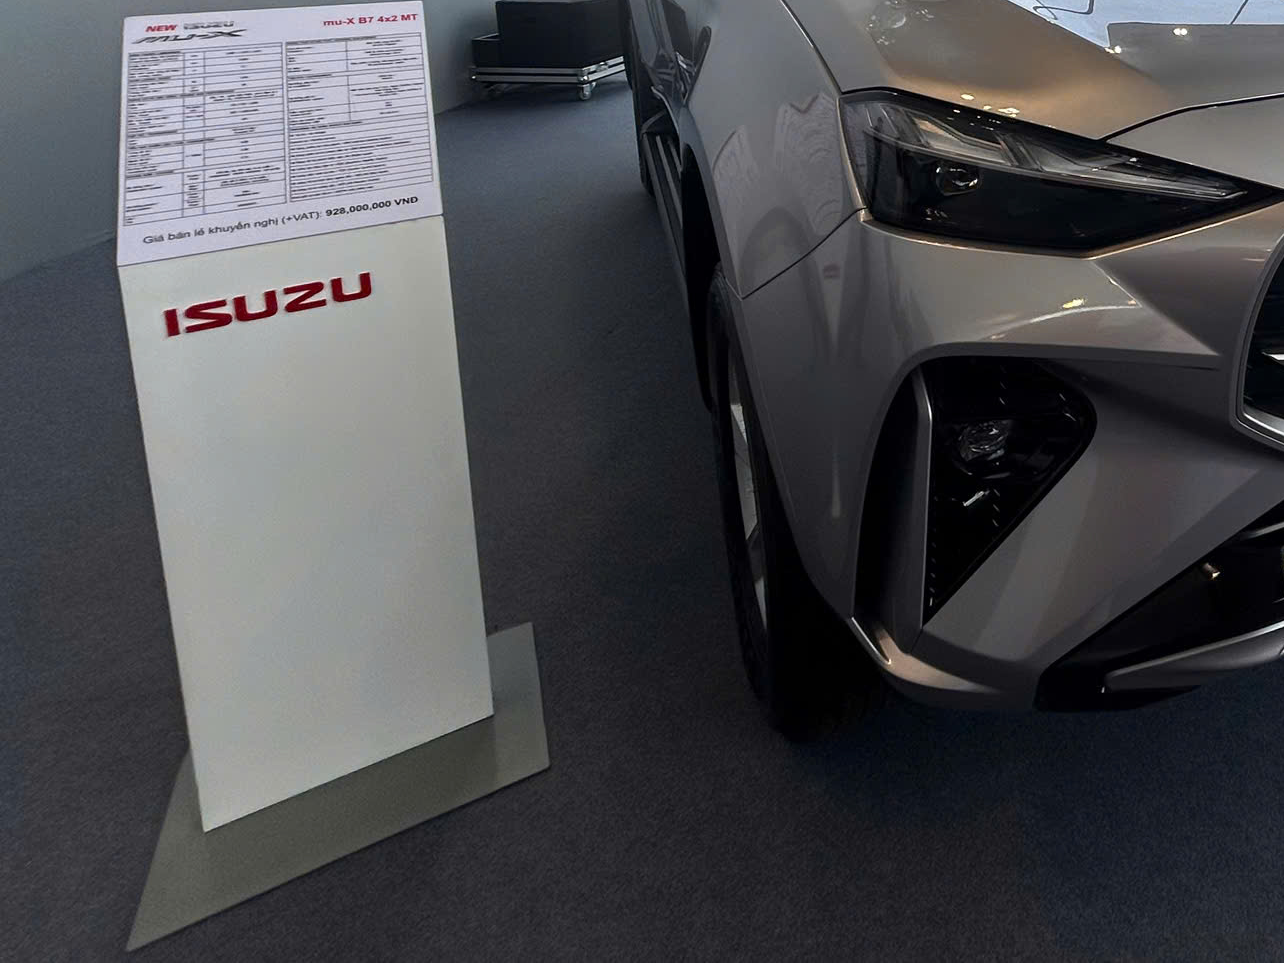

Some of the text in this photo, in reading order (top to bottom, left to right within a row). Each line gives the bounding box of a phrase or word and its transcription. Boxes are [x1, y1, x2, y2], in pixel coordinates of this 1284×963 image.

[145, 23, 178, 33] NEW
[323, 13, 418, 27] mu-X B7 4x2 MT
[142, 233, 165, 244] Giá
[281, 211, 322, 224] (+VAT):
[325, 200, 391, 216] 928,000,000
[163, 272, 372, 338] ISUZU
